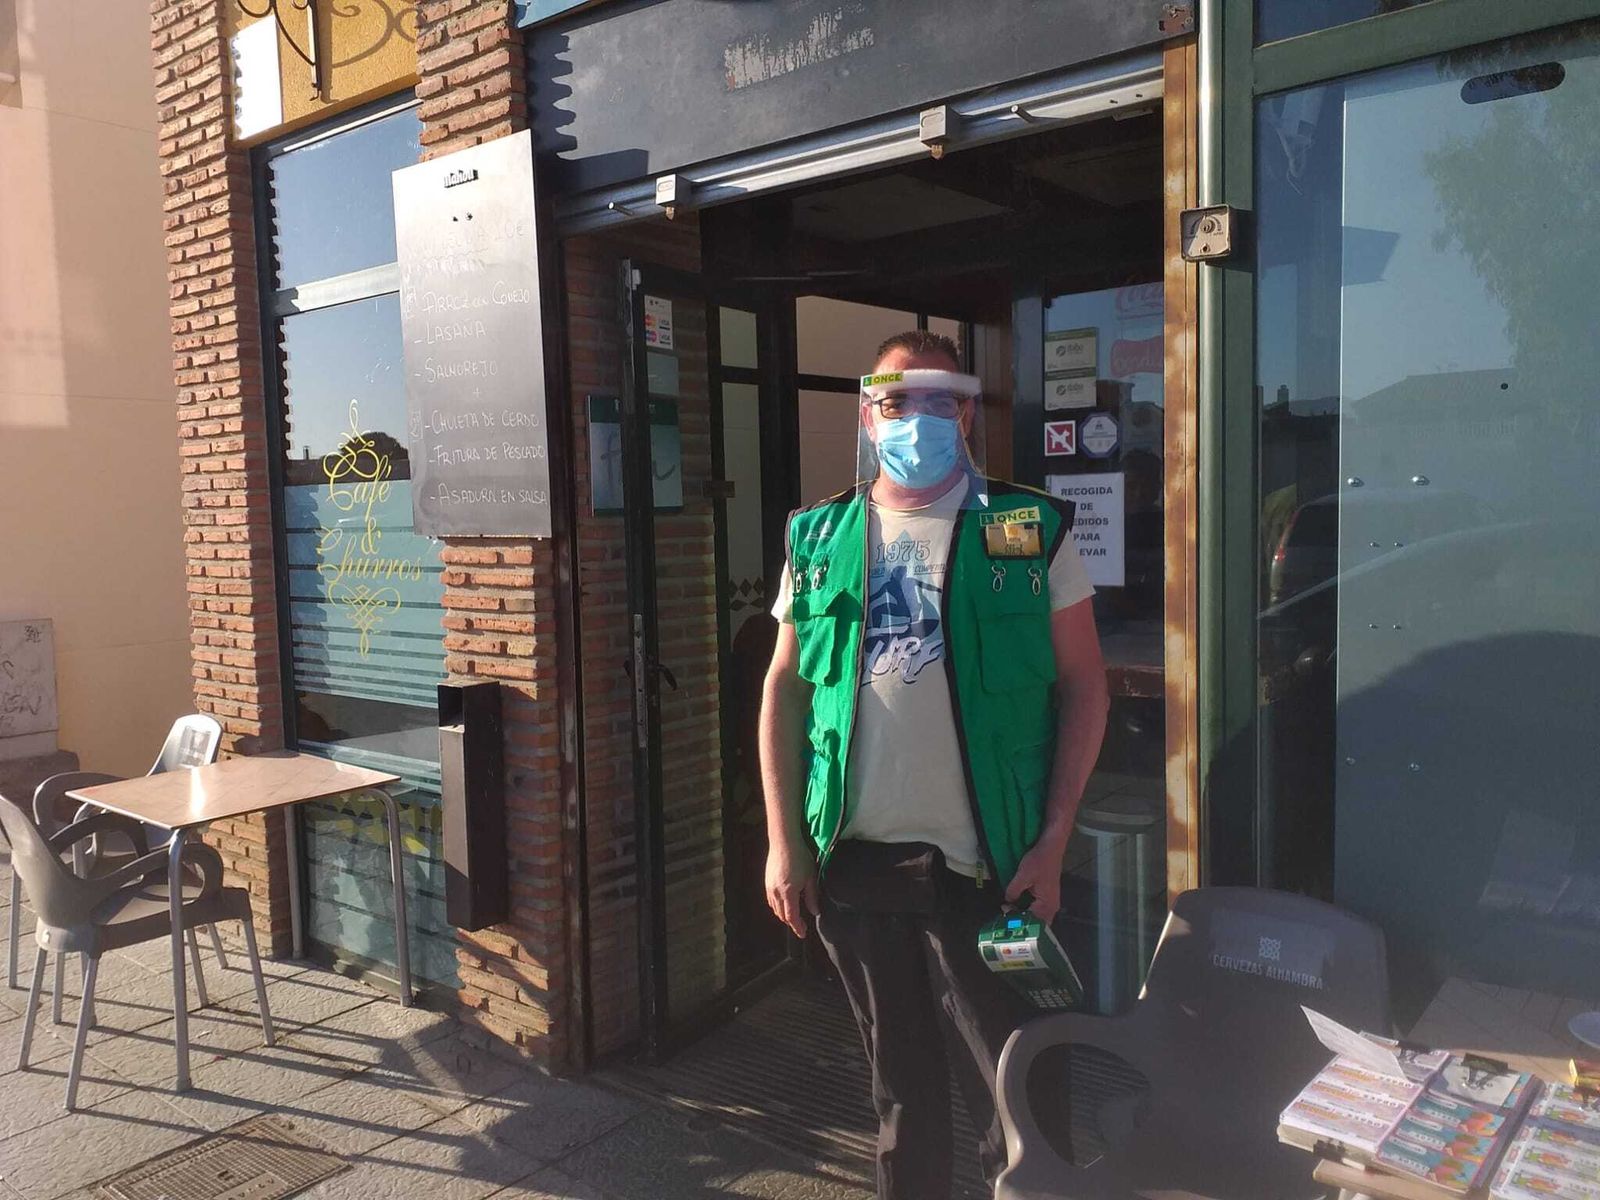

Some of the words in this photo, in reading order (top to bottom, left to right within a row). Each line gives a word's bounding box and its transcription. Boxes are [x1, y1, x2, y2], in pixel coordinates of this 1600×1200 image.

[873, 373, 902, 385] ONCE
[483, 412, 495, 426] DE
[501, 409, 539, 427] CERDO
[485, 447, 498, 461] DE
[501, 489, 515, 504] EN
[1060, 486, 1113, 497] RECOGIDA
[1080, 502, 1094, 511] DE
[997, 509, 1036, 524] ONCE
[1074, 517, 1109, 526] EDIDOS
[1073, 533, 1101, 542] PARA
[876, 540, 931, 564] 1975
